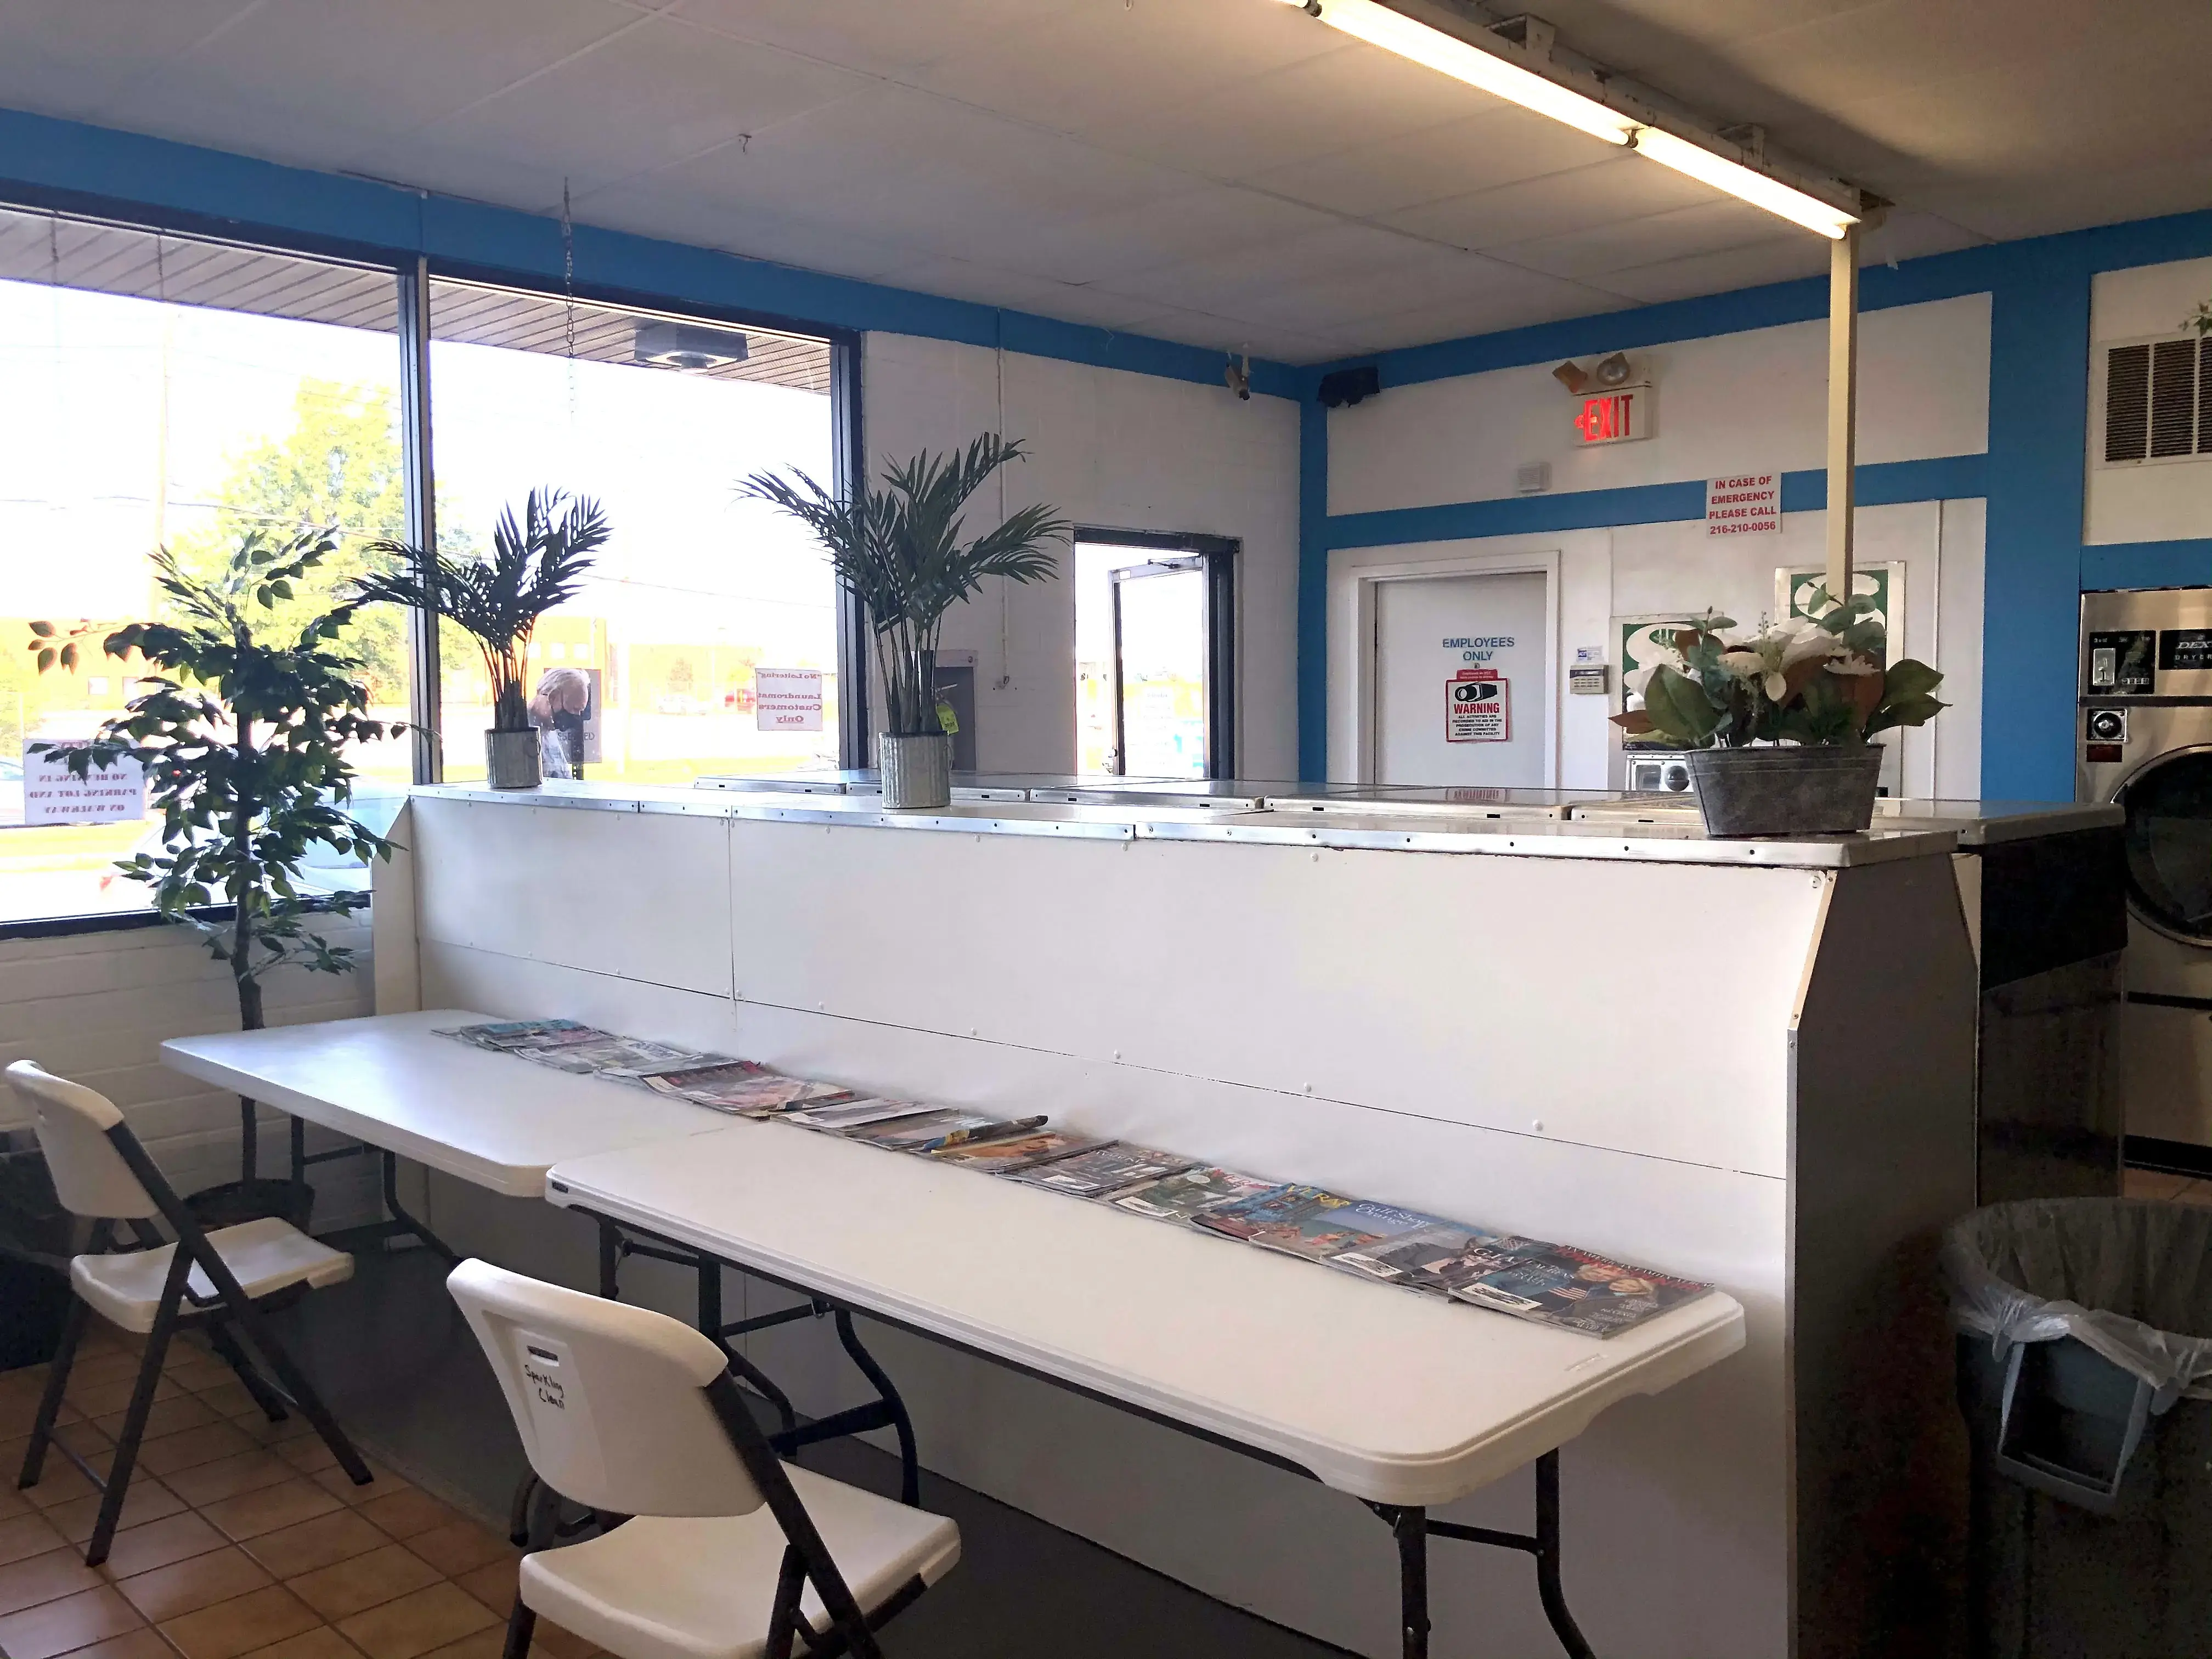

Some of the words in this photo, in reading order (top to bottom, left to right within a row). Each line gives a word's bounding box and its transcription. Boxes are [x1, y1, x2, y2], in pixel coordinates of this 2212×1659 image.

[1583, 394, 1634, 442] EXIT
[1715, 480, 1725, 489] IN
[1729, 477, 1756, 488] CASE
[1758, 476, 1772, 485] OF
[1711, 491, 1774, 504] EMERGENCY
[1709, 509, 1747, 520] PLEASE
[1750, 506, 1777, 516] CALL
[1710, 521, 1776, 534] 216-210-0056
[1442, 637, 1515, 648] EMPLOYEES
[1463, 651, 1493, 661] ONLY
[1454, 703, 1500, 714] WARNING
[539, 1388, 565, 1410] Clean
